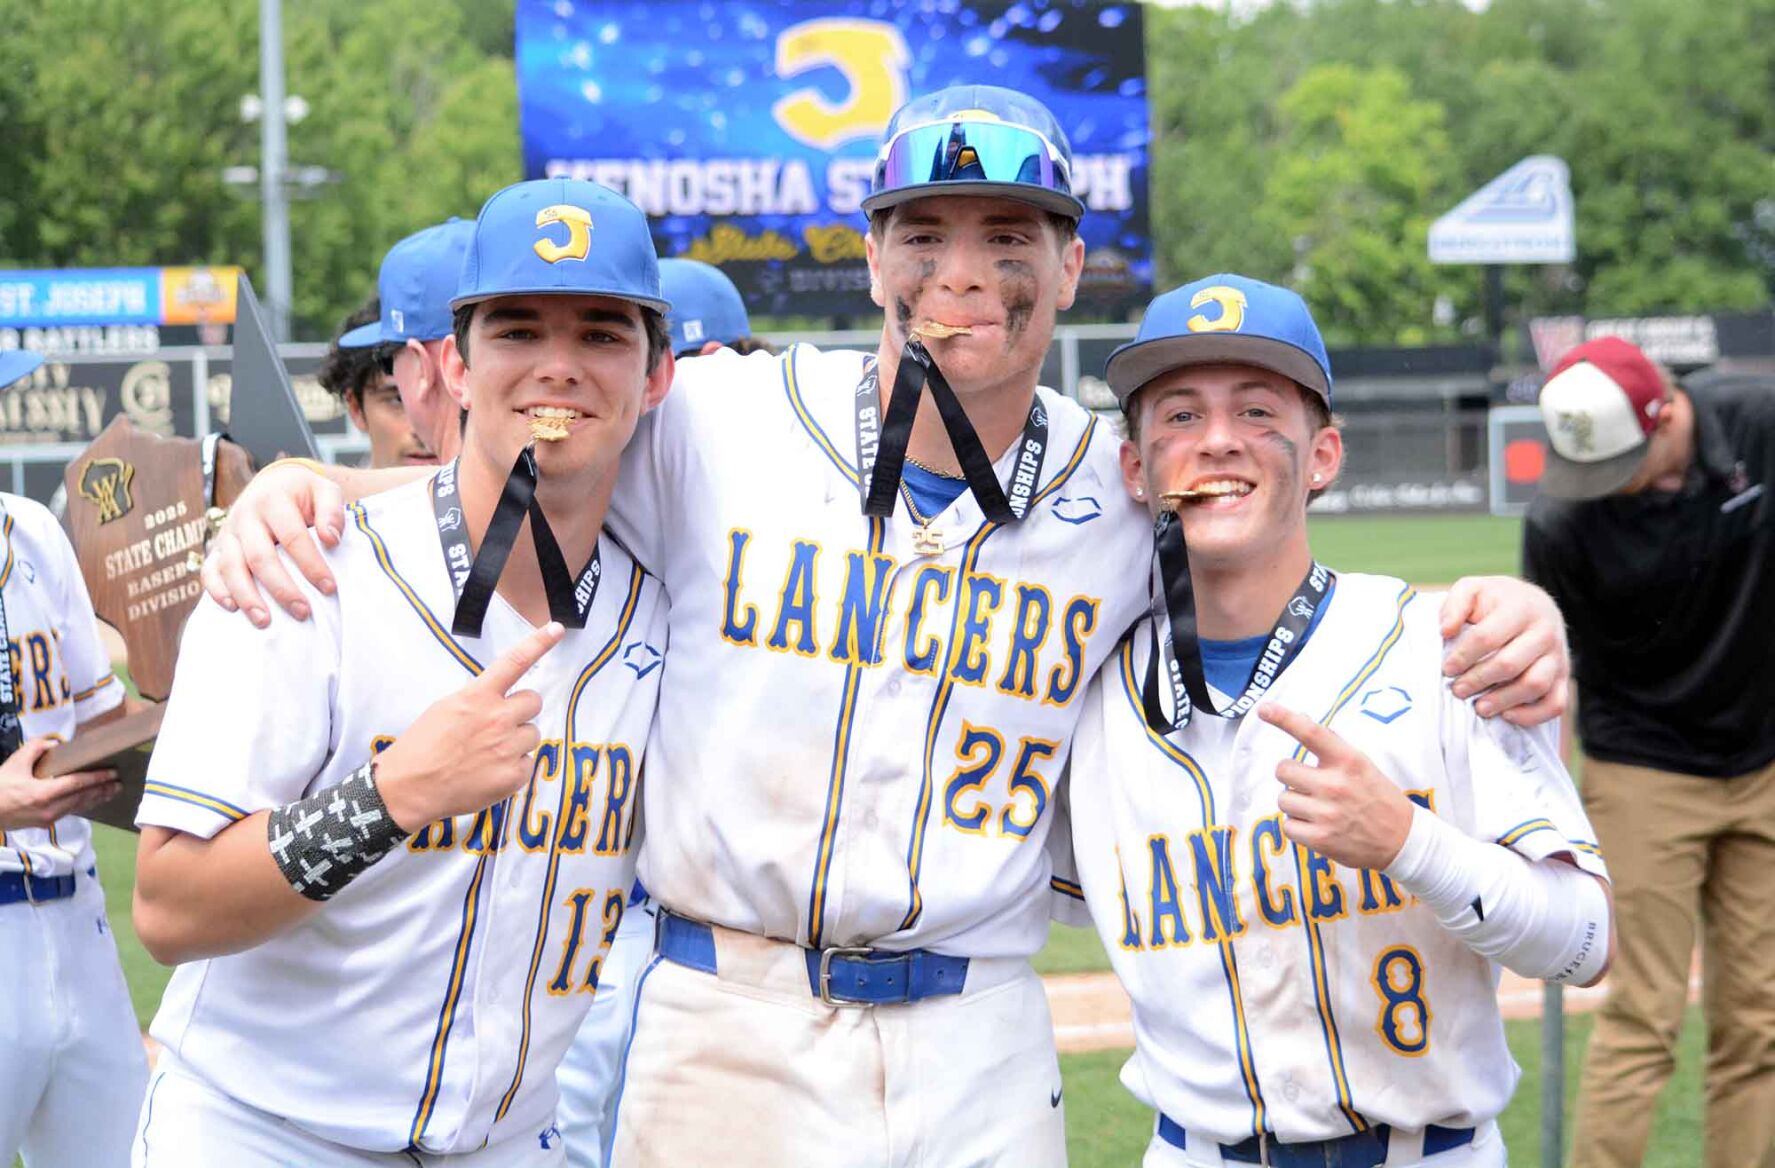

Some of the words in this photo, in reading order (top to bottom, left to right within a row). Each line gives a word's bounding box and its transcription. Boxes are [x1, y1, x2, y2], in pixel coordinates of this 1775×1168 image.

[546, 157, 818, 215] ENOSHA
[104, 539, 153, 580] STATE
[154, 517, 206, 560] CHAMP
[127, 561, 187, 597] BASEB
[127, 580, 200, 622] DIVISIO
[719, 526, 1102, 708] LANCERS
[941, 718, 1064, 842] 25
[1369, 944, 1434, 1058] 8
